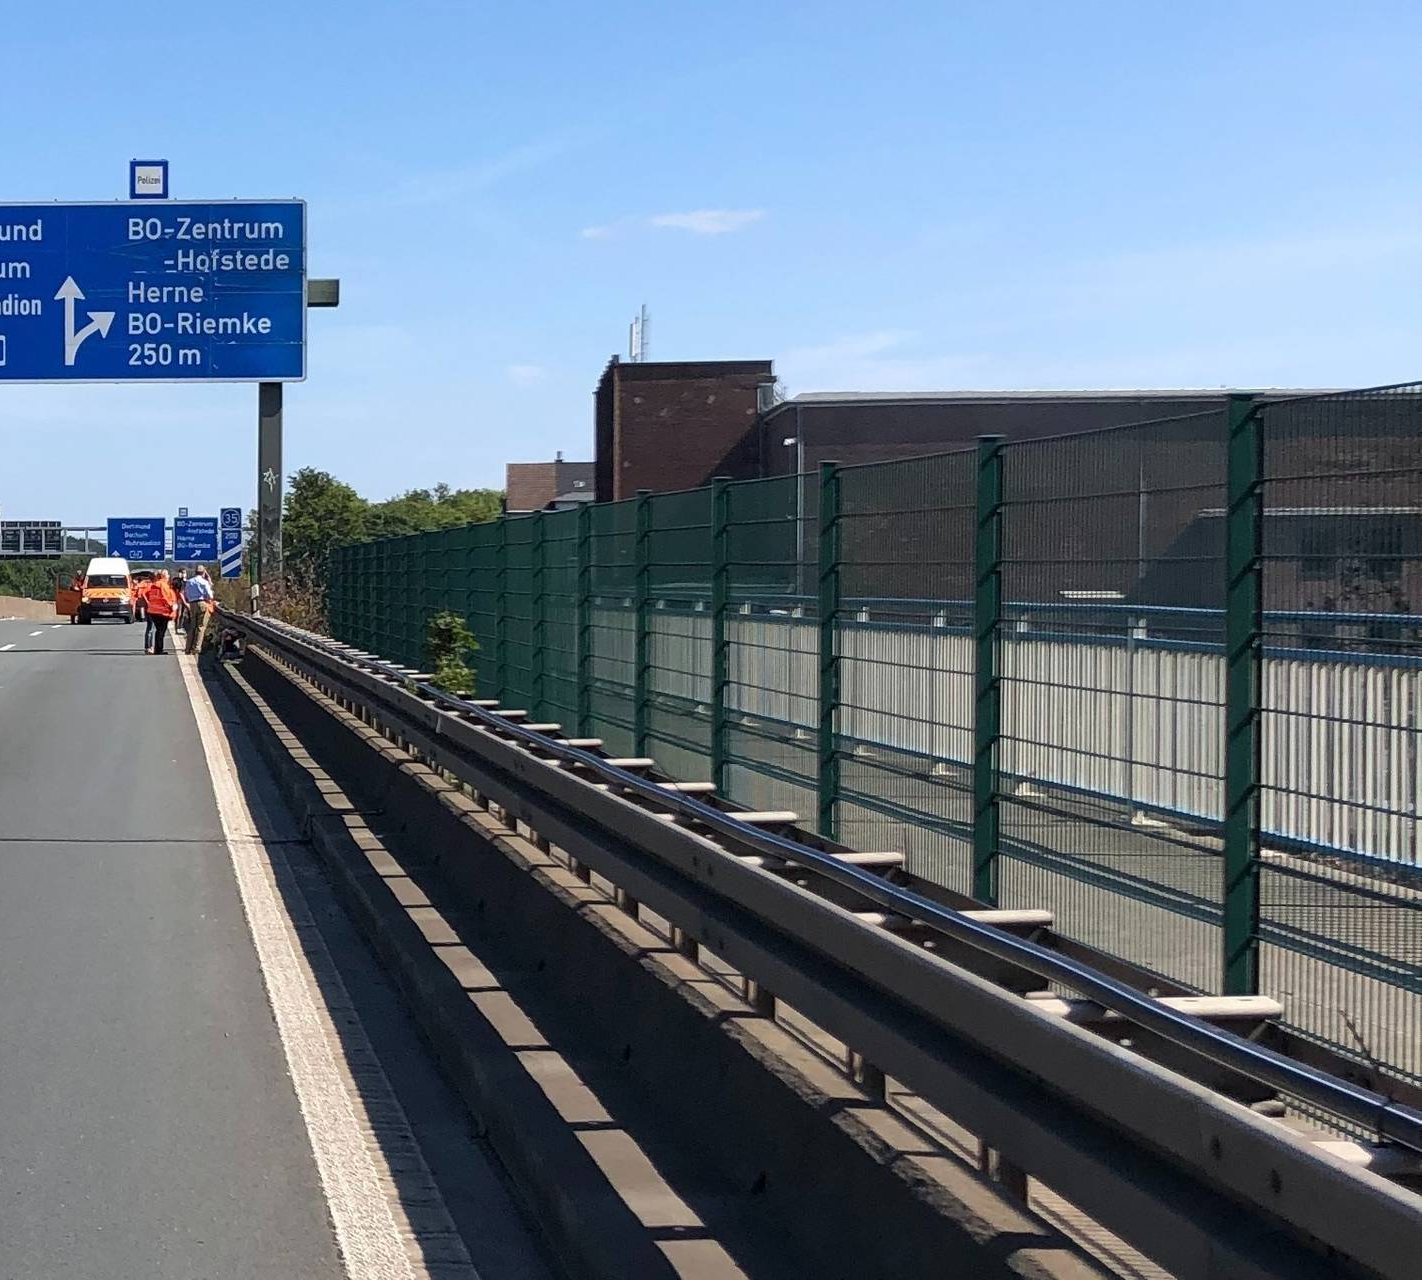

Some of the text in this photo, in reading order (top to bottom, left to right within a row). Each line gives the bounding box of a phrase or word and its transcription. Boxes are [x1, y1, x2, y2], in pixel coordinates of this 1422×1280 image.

[137, 175, 161, 185] Polizei
[128, 217, 284, 241] BO-Zentrum
[163, 248, 290, 271] -Hofstede
[128, 281, 204, 303] Herne
[128, 311, 272, 335] BO-Riemke
[128, 343, 201, 365] 250 m
[224, 513, 238, 524] 35
